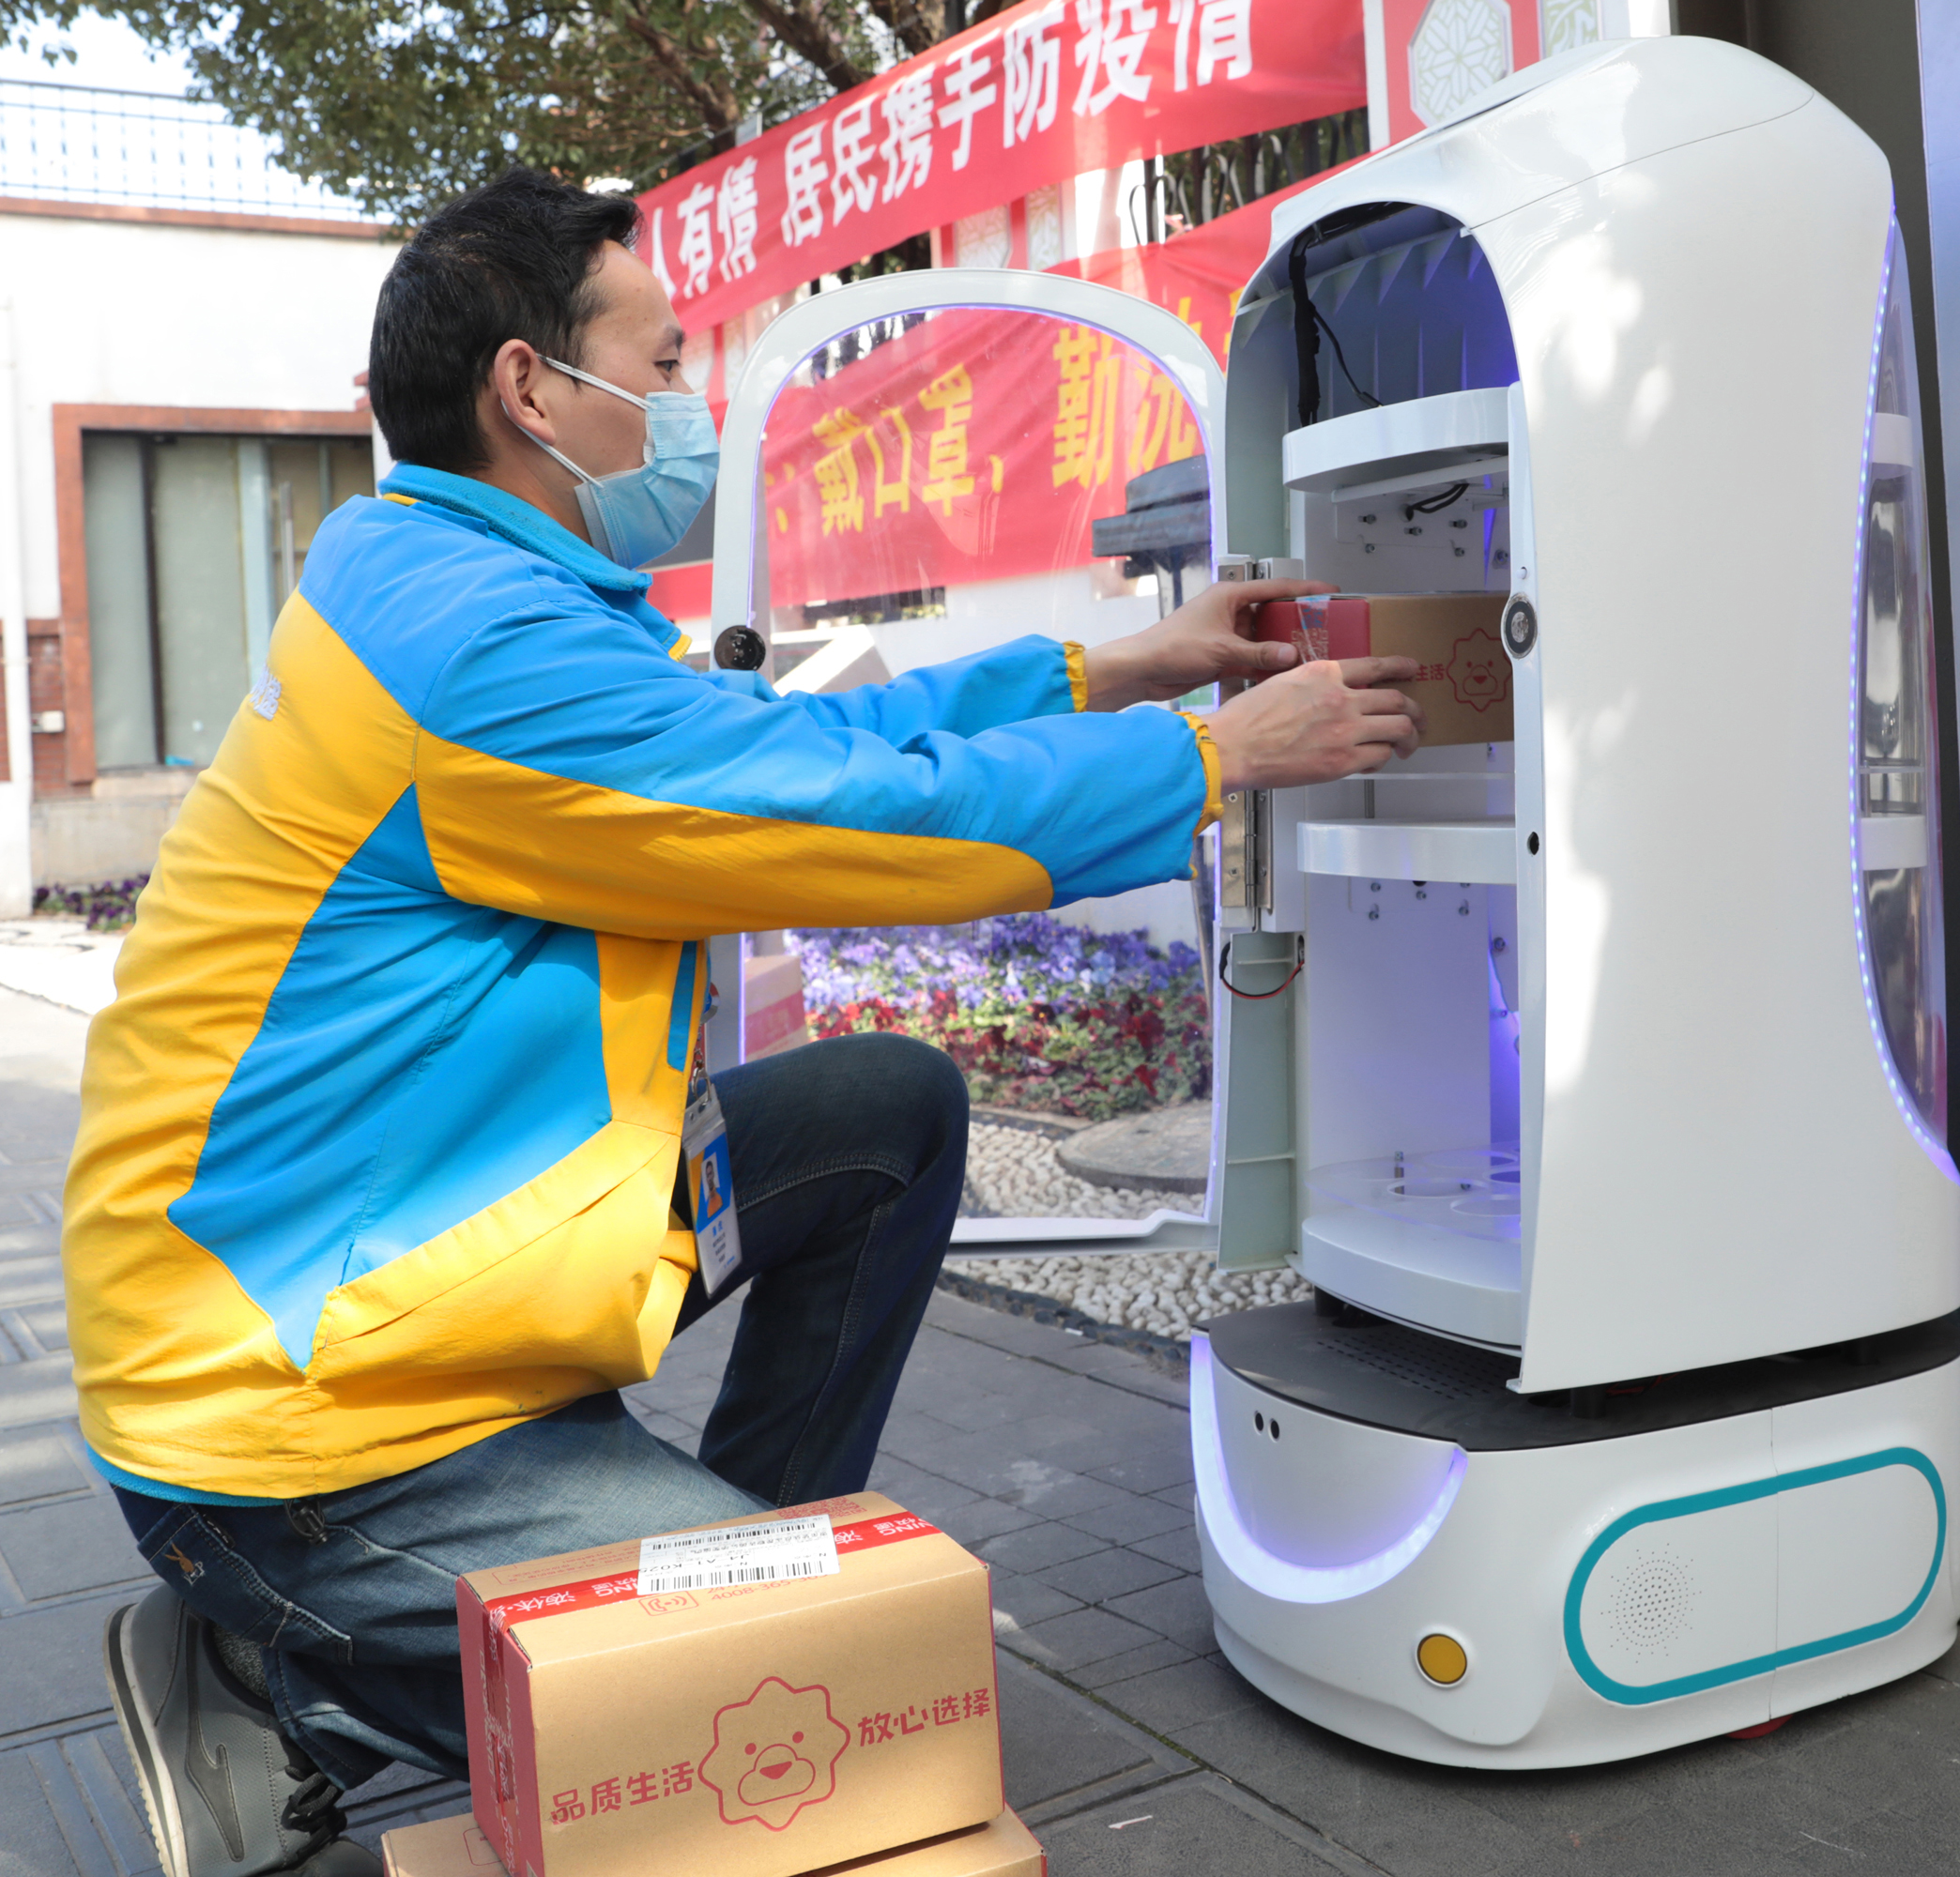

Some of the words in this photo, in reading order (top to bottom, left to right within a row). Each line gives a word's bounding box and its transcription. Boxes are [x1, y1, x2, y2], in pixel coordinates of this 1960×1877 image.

[857, 1687, 991, 1747] 放心选择
[550, 1761, 695, 1825] 品质生活
